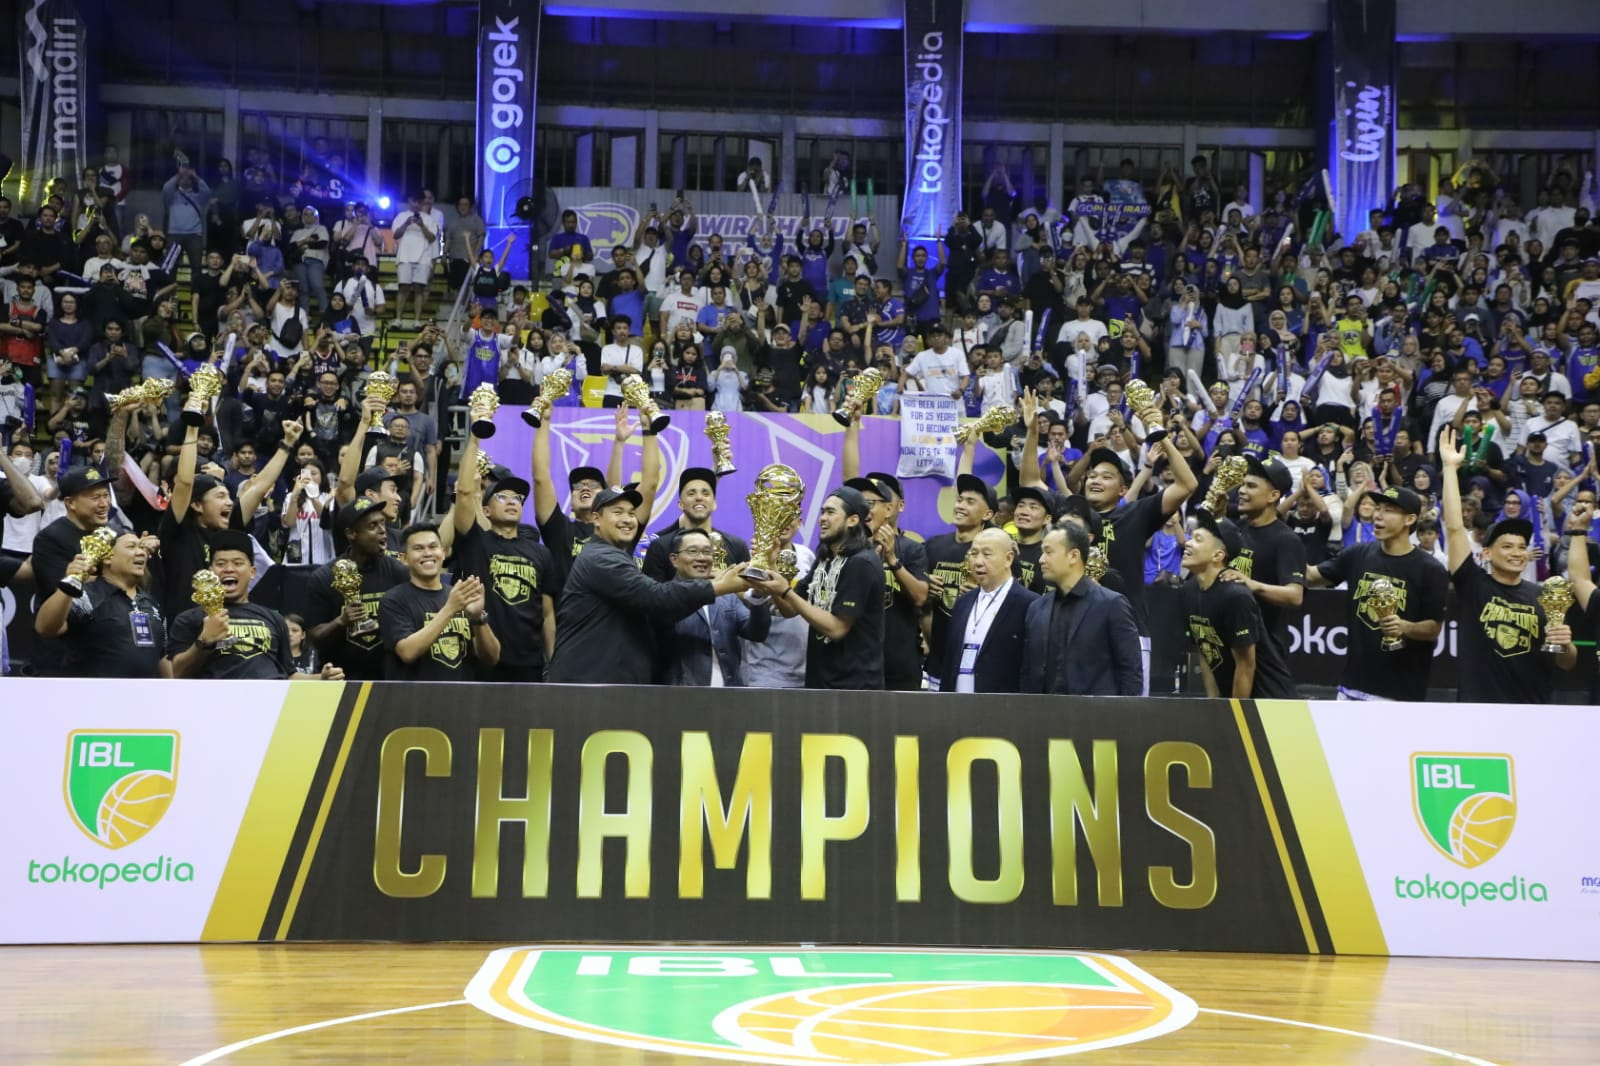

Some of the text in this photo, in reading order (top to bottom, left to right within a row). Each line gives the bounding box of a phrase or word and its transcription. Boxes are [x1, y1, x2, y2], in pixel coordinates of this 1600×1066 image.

[46, 18, 77, 149] mandiri
[488, 15, 524, 129] gojek
[915, 31, 950, 193] tokopedia
[911, 411, 957, 421] FOR 25 YEARS
[918, 399, 935, 409] BEEN
[916, 423, 950, 433] TO BECOME
[78, 742, 135, 767] IBL
[1422, 763, 1476, 789] IBL
[371, 726, 1219, 910] CHAMPIONS
[27, 855, 195, 890] tokopedia
[1394, 873, 1549, 907] tokopedia
[575, 955, 894, 978] IBL
